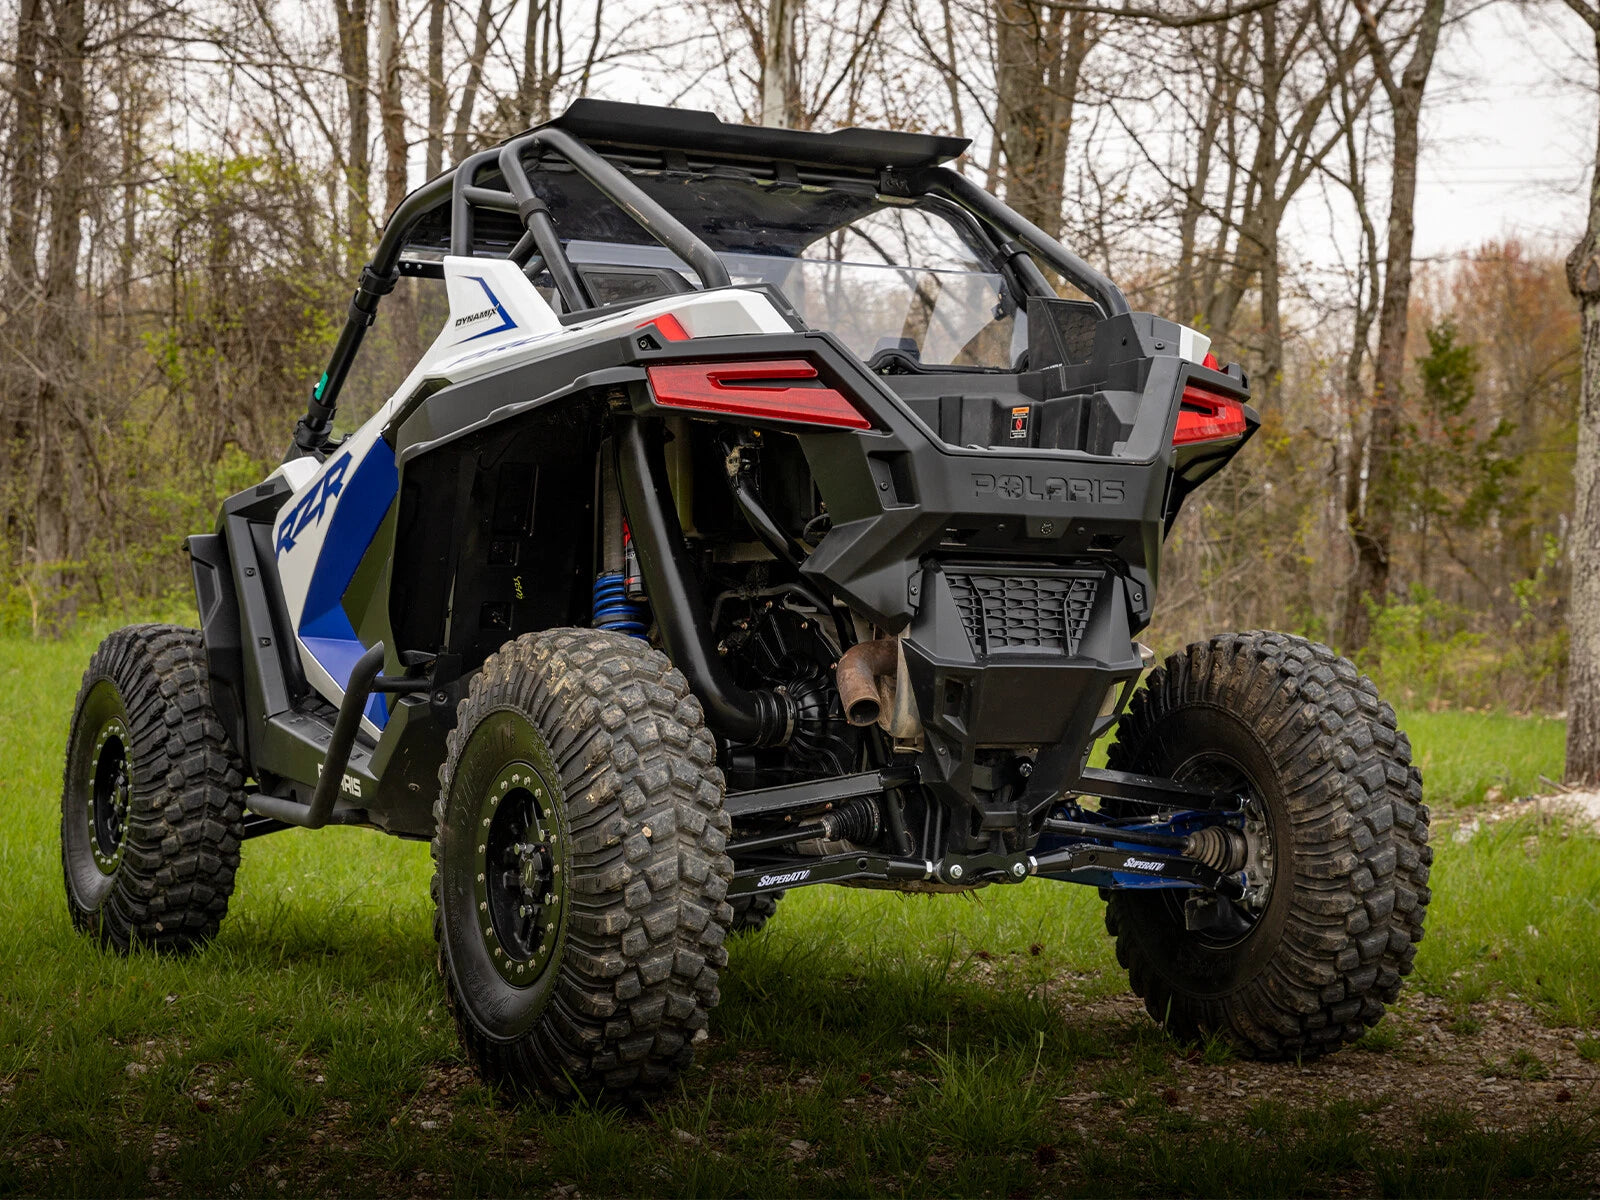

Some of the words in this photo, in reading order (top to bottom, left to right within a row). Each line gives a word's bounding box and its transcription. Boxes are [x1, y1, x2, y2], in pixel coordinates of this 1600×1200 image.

[455, 303, 500, 328] DYNAMIX
[970, 473, 1126, 505] POLARIS
[275, 450, 353, 561] RZR
